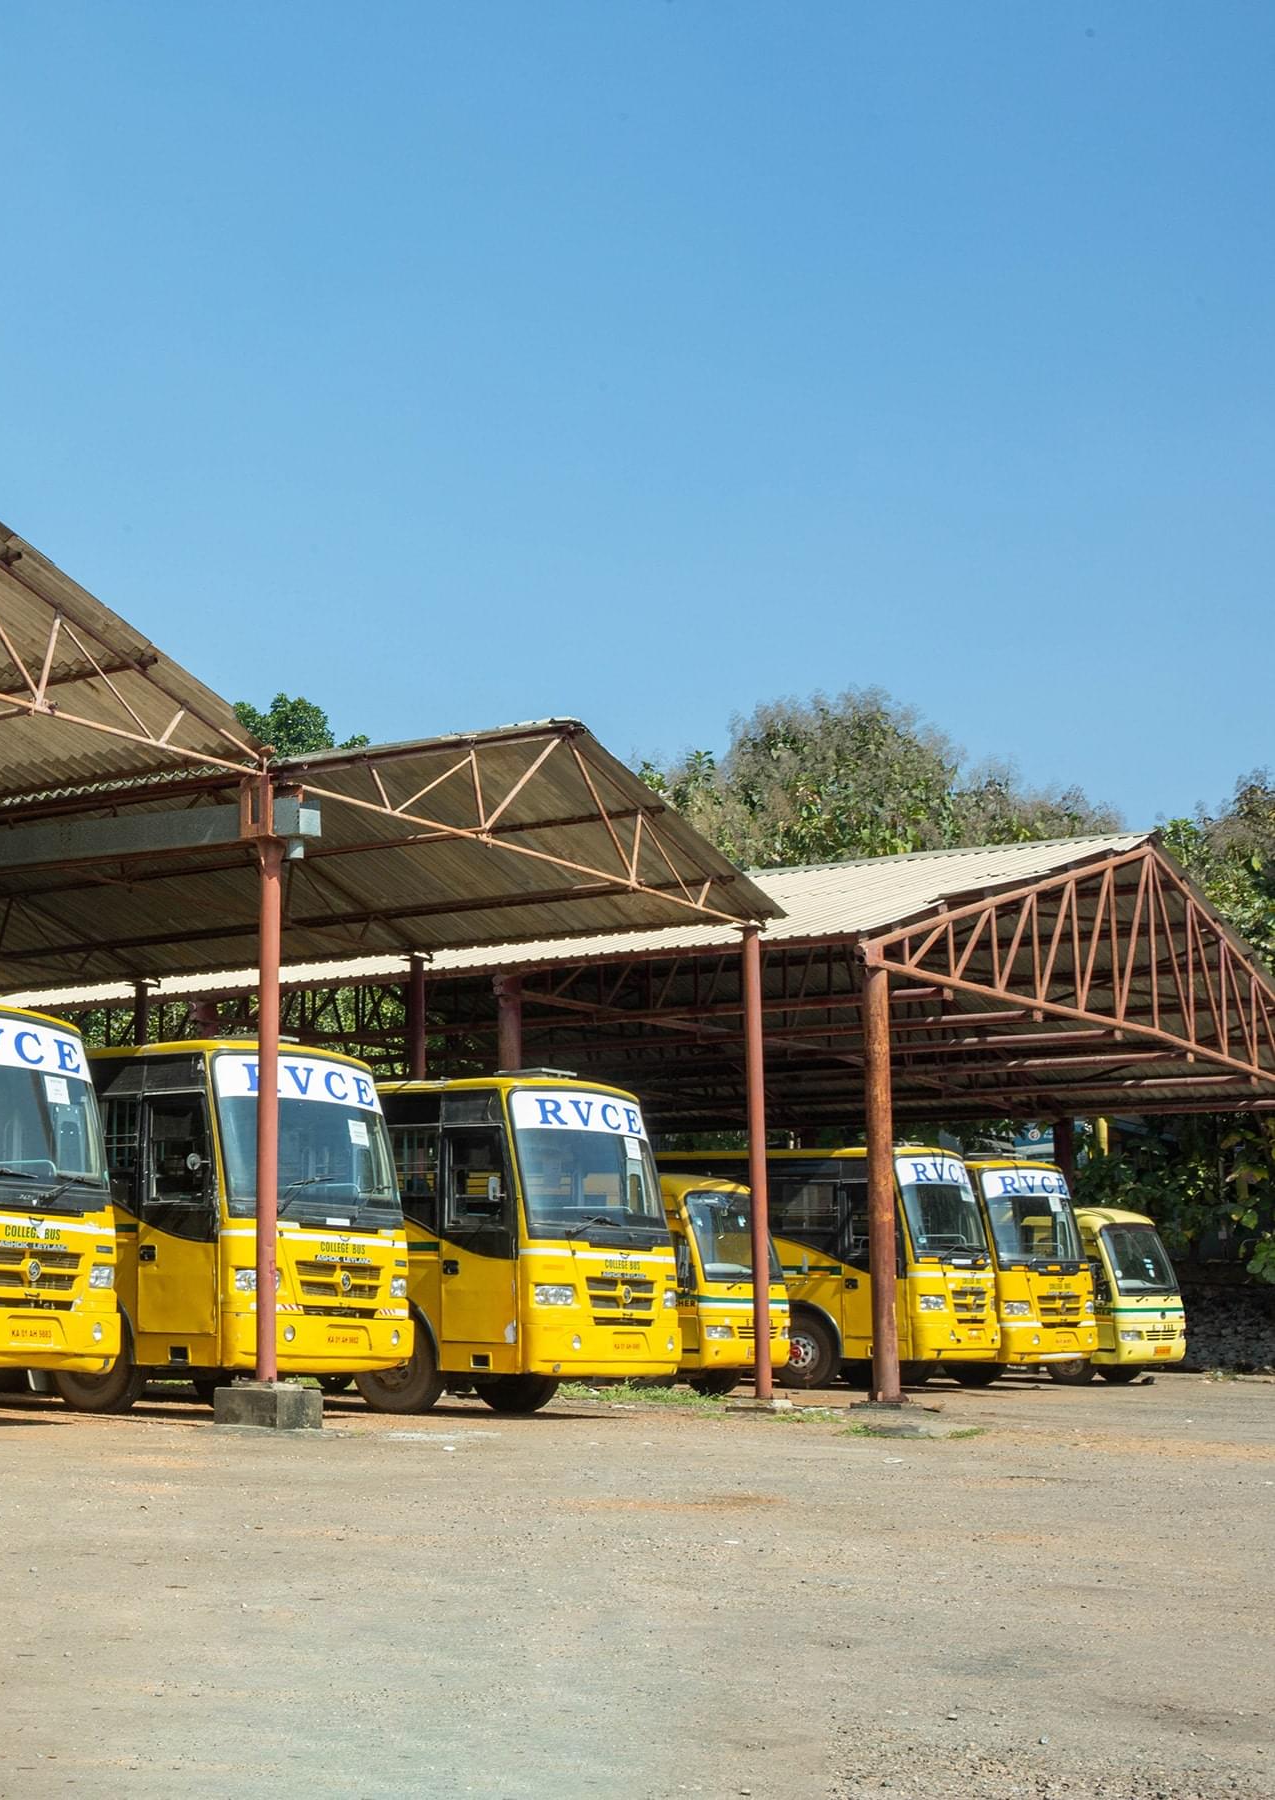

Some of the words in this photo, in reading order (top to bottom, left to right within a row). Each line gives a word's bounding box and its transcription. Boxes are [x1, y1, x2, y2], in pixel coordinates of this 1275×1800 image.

[535, 1098, 642, 1134] RVCE
[998, 1175, 1068, 1195] RVCE
[44, 1228, 61, 1240] BUS
[320, 1241, 349, 1253] COLLEGE
[352, 1244, 366, 1254] BUS
[605, 1259, 629, 1269] COLLEGE
[630, 1261, 641, 1270] BUS
